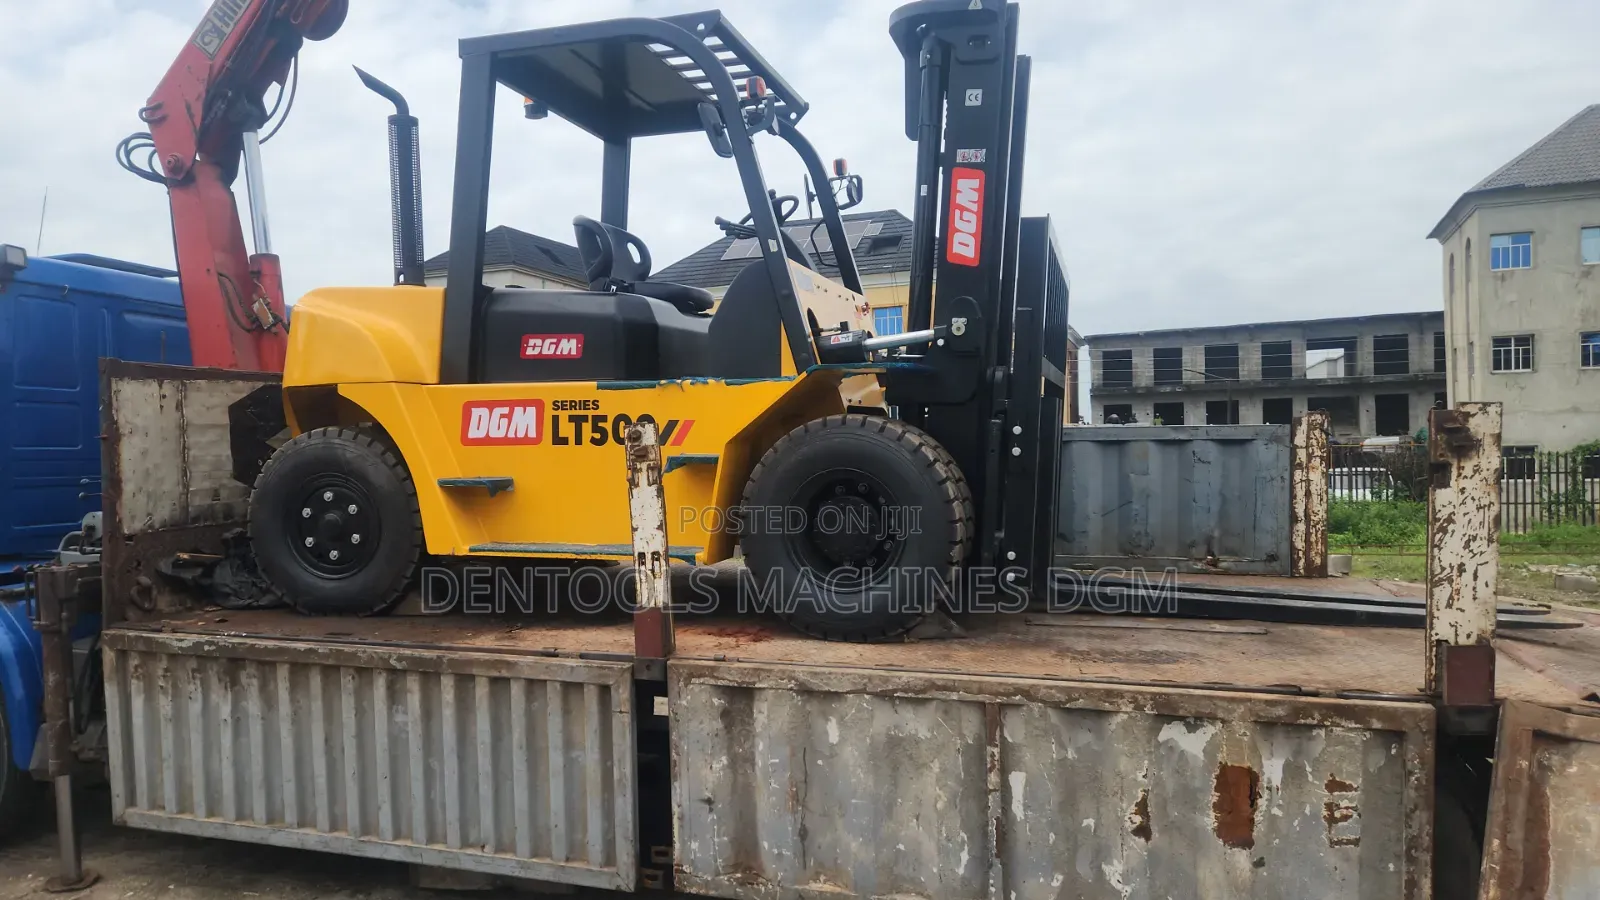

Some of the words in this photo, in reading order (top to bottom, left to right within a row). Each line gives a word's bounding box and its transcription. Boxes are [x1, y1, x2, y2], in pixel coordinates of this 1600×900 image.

[953, 179, 980, 258] DGM
[525, 338, 577, 355] DGM
[551, 400, 600, 411] SERIES
[467, 406, 537, 438] DGM
